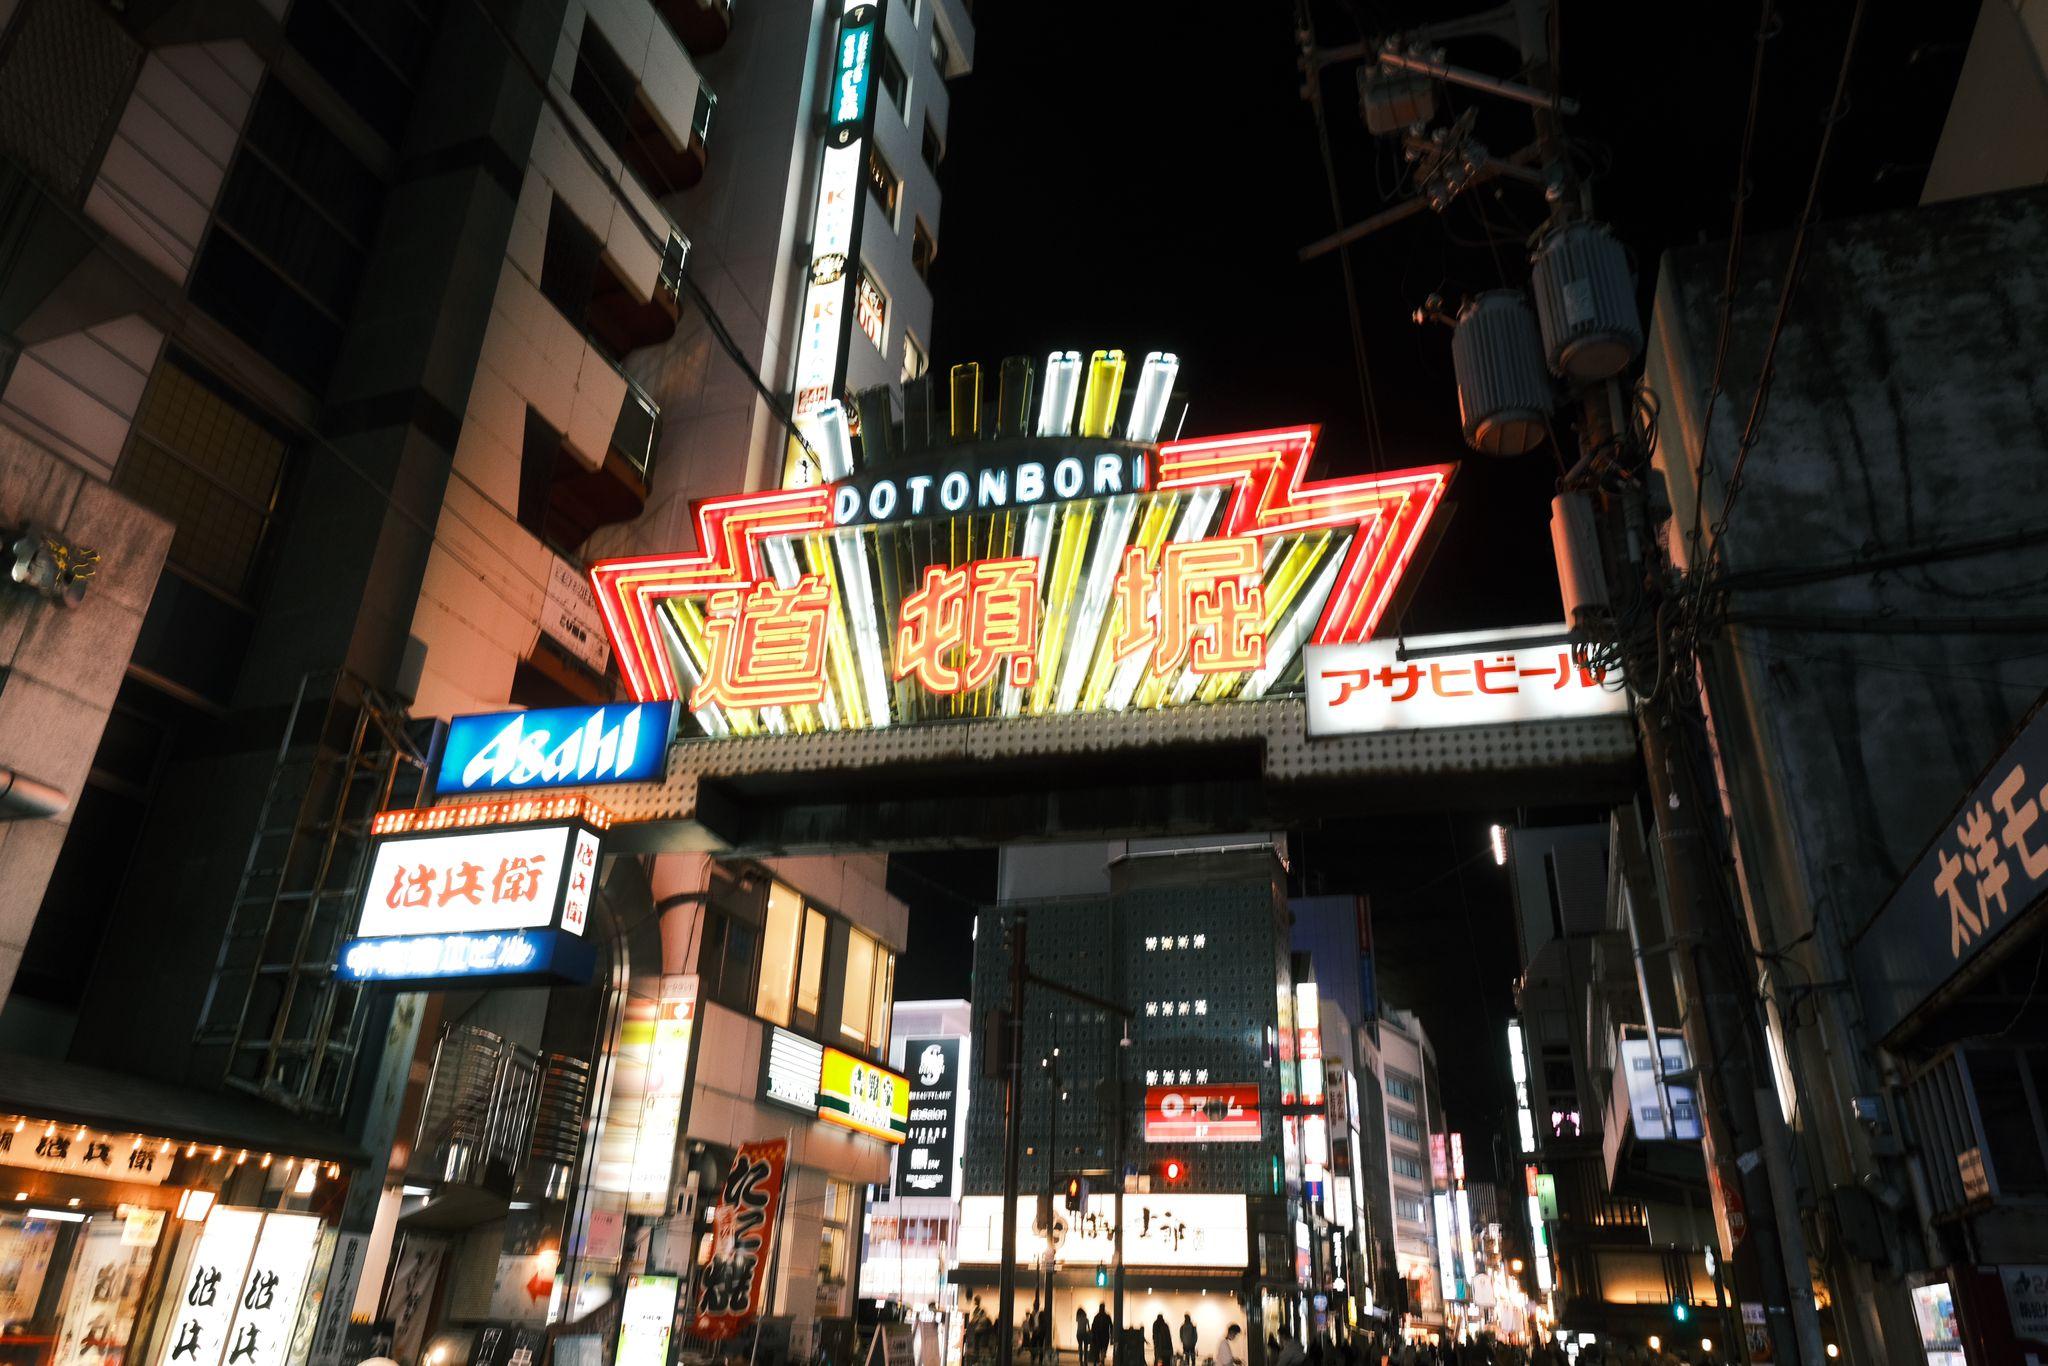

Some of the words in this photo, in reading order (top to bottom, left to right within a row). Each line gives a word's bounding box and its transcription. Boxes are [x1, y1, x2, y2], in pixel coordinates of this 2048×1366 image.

[834, 453, 1146, 524] DOTONBORI
[689, 536, 1268, 712] 道頓堀
[462, 704, 642, 788] Asahi
[1934, 764, 2048, 960] 太洋モ
